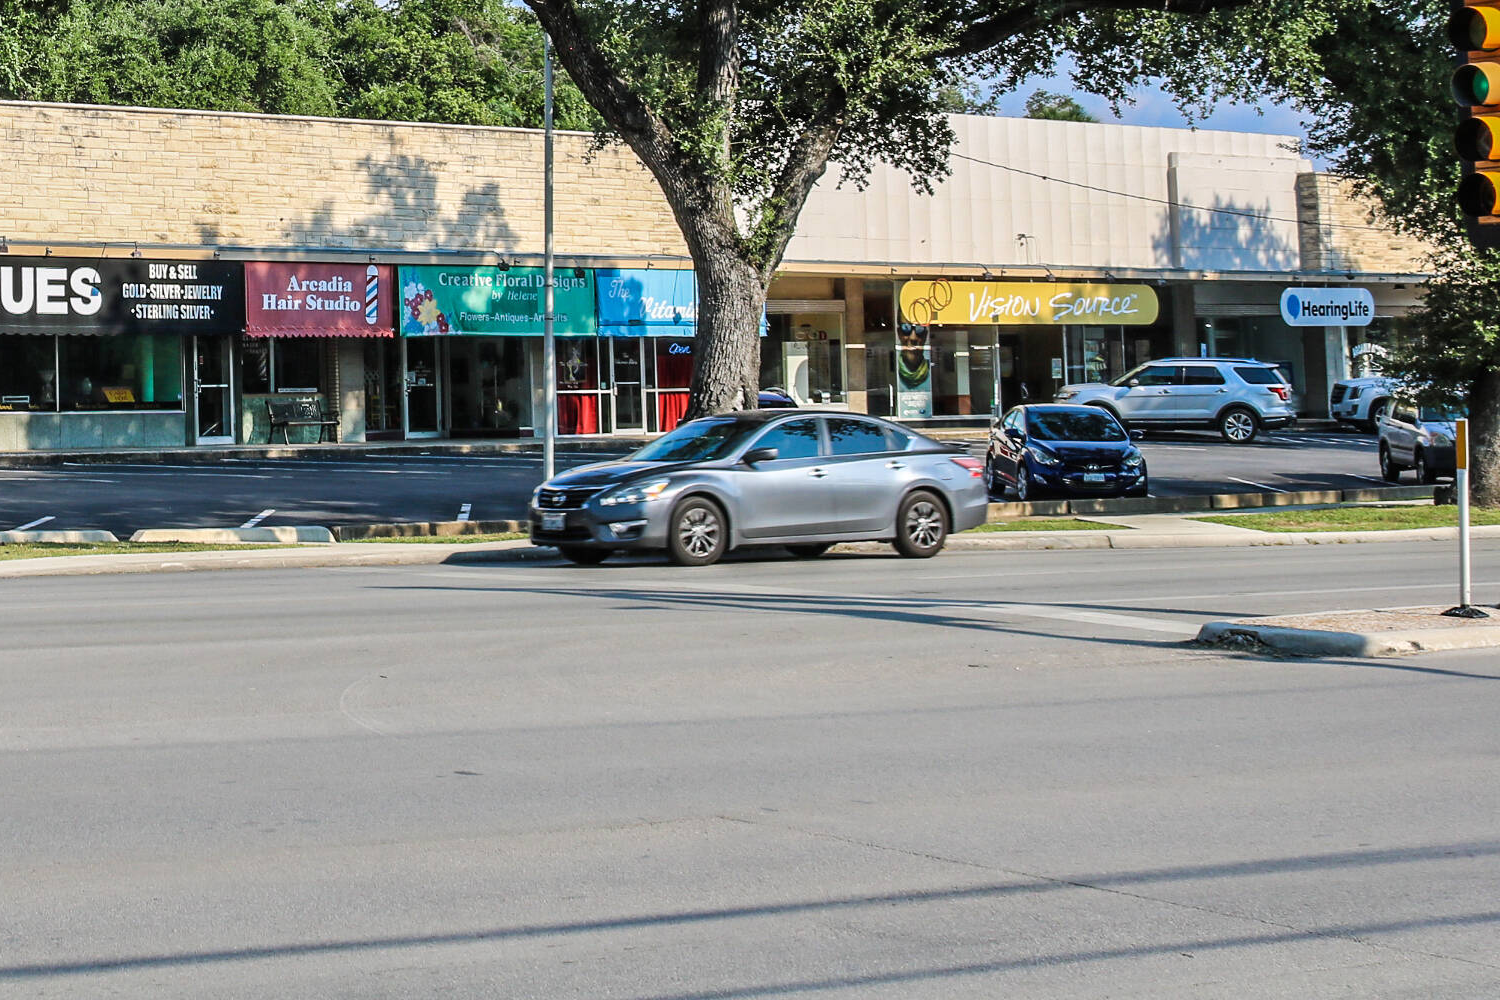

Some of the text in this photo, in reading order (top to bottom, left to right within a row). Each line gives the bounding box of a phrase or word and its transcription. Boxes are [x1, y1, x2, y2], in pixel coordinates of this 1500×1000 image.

[148, 263, 198, 280] BUY & SELL
[287, 275, 353, 292] Arcadia
[438, 273, 586, 291] Creative Floral Dsigns
[609, 279, 632, 298] The
[262, 294, 361, 312] Hair Studio
[491, 290, 503, 302] by
[135, 304, 179, 319] STERLING
[1301, 300, 1369, 321] HearingLife
